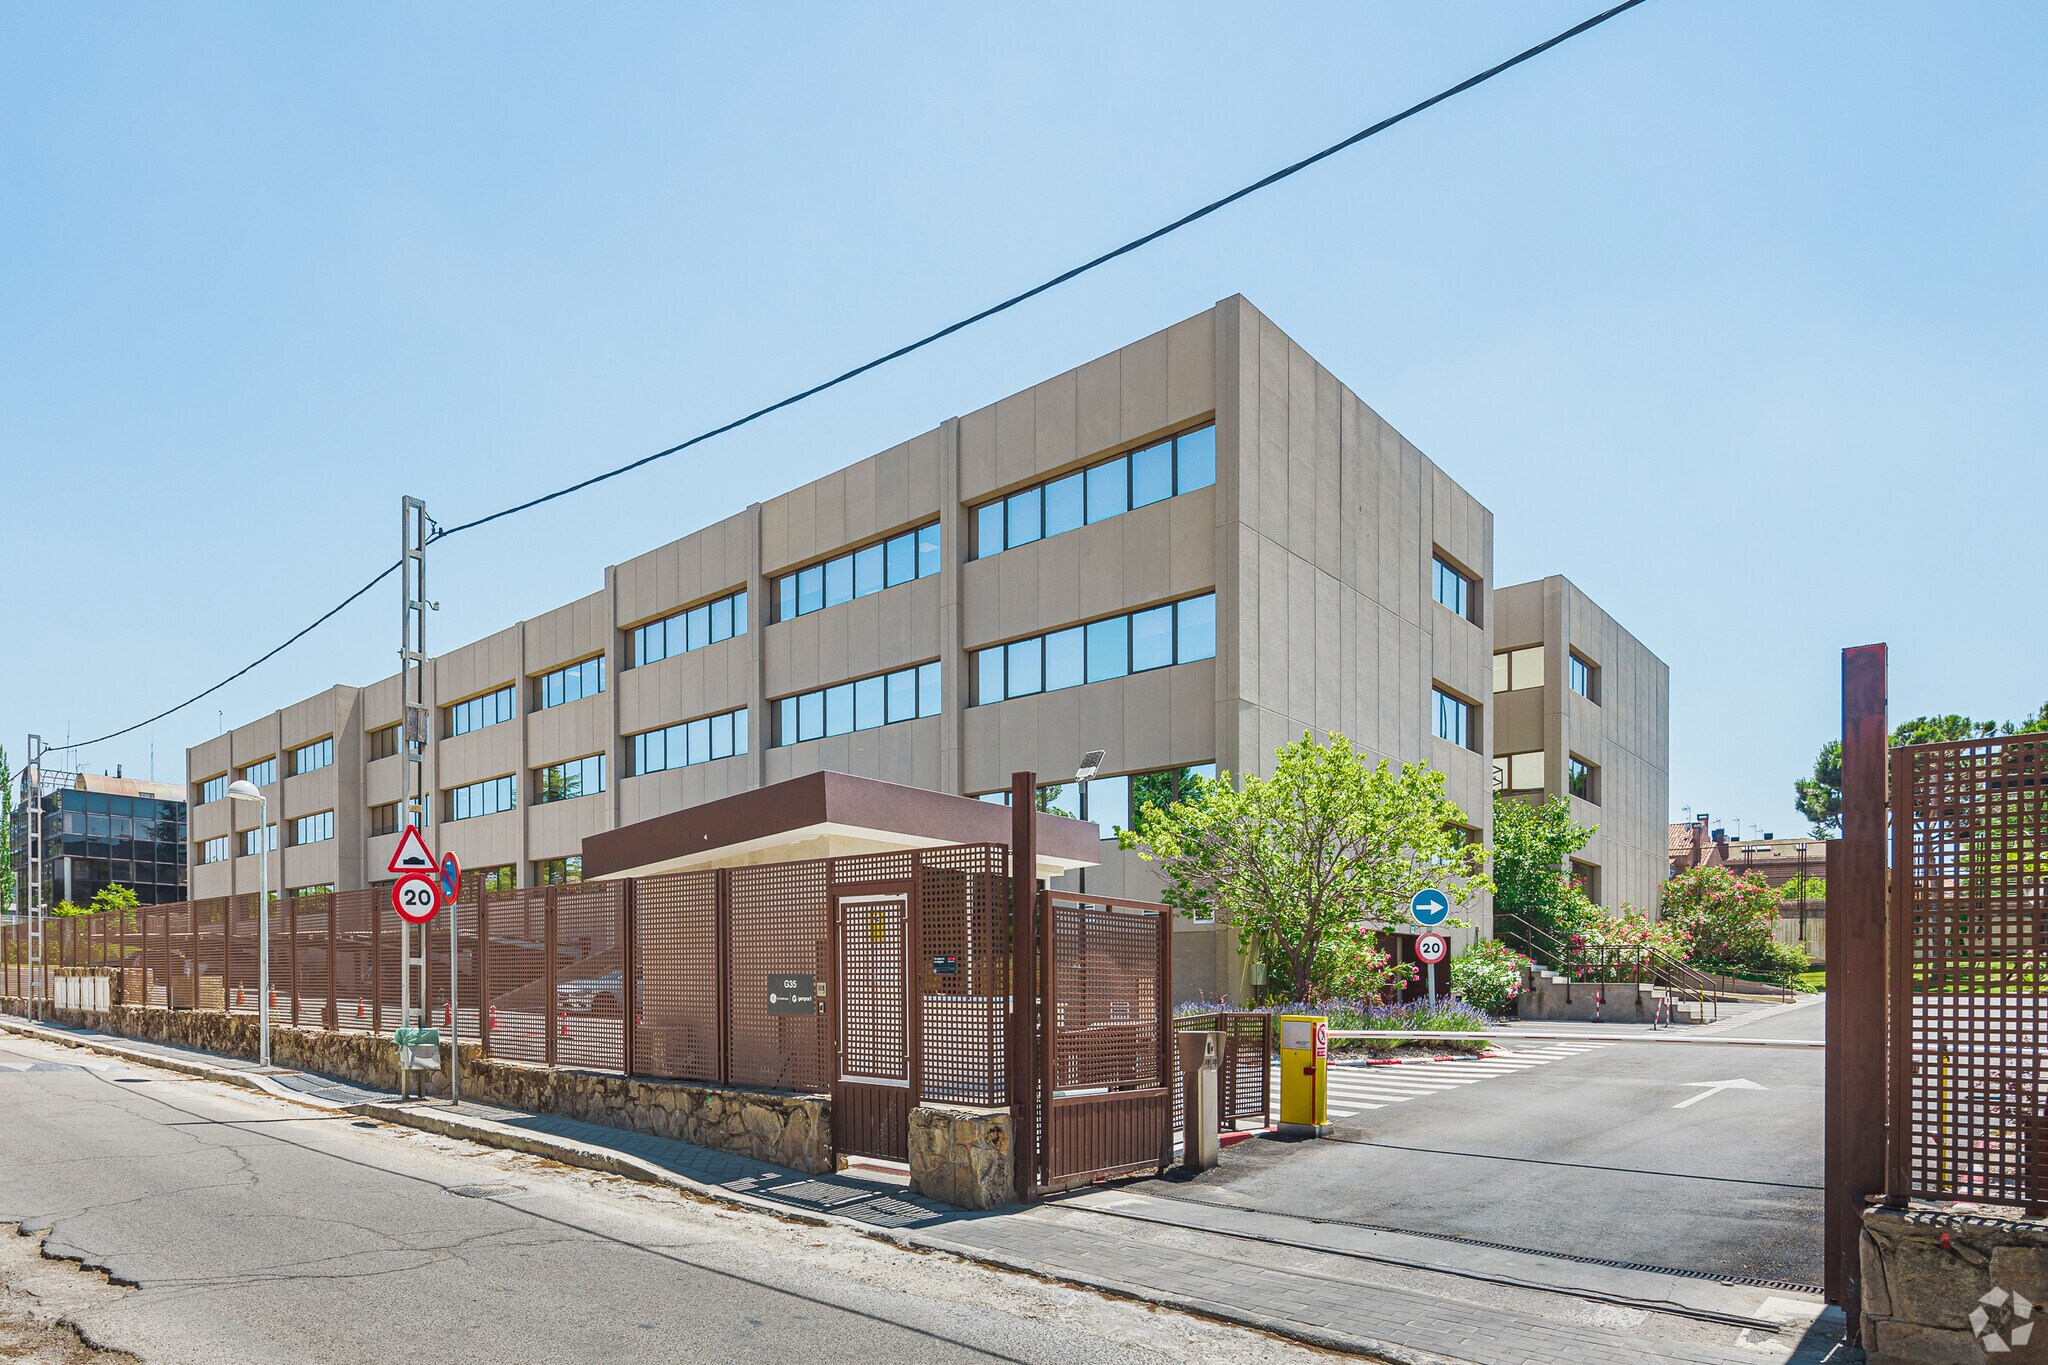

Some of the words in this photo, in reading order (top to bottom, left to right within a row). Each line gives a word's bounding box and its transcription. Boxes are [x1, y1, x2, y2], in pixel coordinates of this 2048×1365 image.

[404, 889, 431, 906] 20
[1422, 942, 1440, 954] 20
[783, 979, 798, 989] G35
